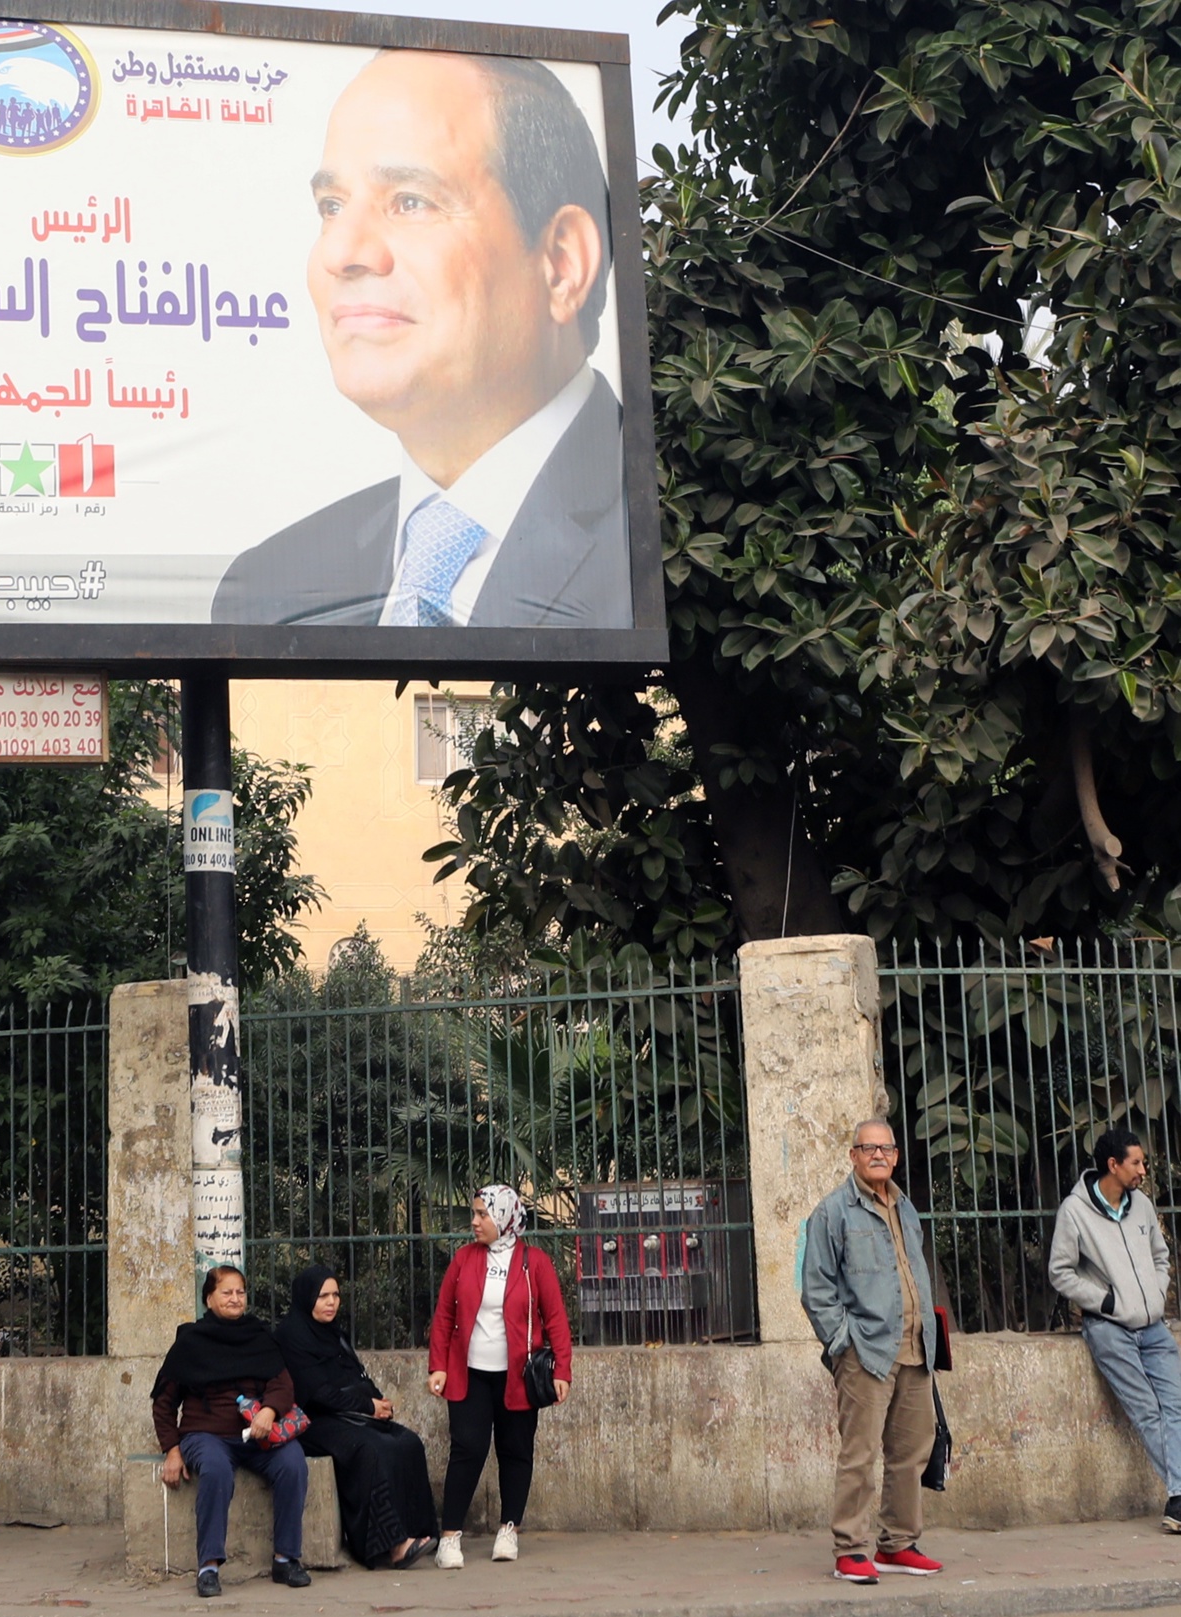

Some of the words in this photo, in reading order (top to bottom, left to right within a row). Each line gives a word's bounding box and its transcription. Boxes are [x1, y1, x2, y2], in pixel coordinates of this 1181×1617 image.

[112, 50, 158, 84] وطن
[160, 52, 240, 88] مستقبل
[245, 62, 288, 92] حزب
[126, 94, 210, 122] القاهرة
[221, 98, 272, 123] أمانة
[32, 196, 131, 243] الرئيس
[76, 260, 289, 347] عبدالفتاح
[106, 358, 189, 419] رئيساً
[39, 503, 58, 516] رمز
[84, 503, 106, 516] رقم
[72, 677, 101, 706] ضع
[20, 710, 38, 728] 30
[42, 710, 60, 728] 90
[63, 710, 81, 728] 20
[84, 710, 101, 727] 39
[42, 738, 71, 756] 403
[77, 738, 102, 755] 401
[191, 826, 231, 843] ONLINE
[197, 853, 207, 868] 91
[210, 853, 227, 868] 403
[203, 1174, 216, 1187] كل
[487, 1266, 507, 1277] SH
